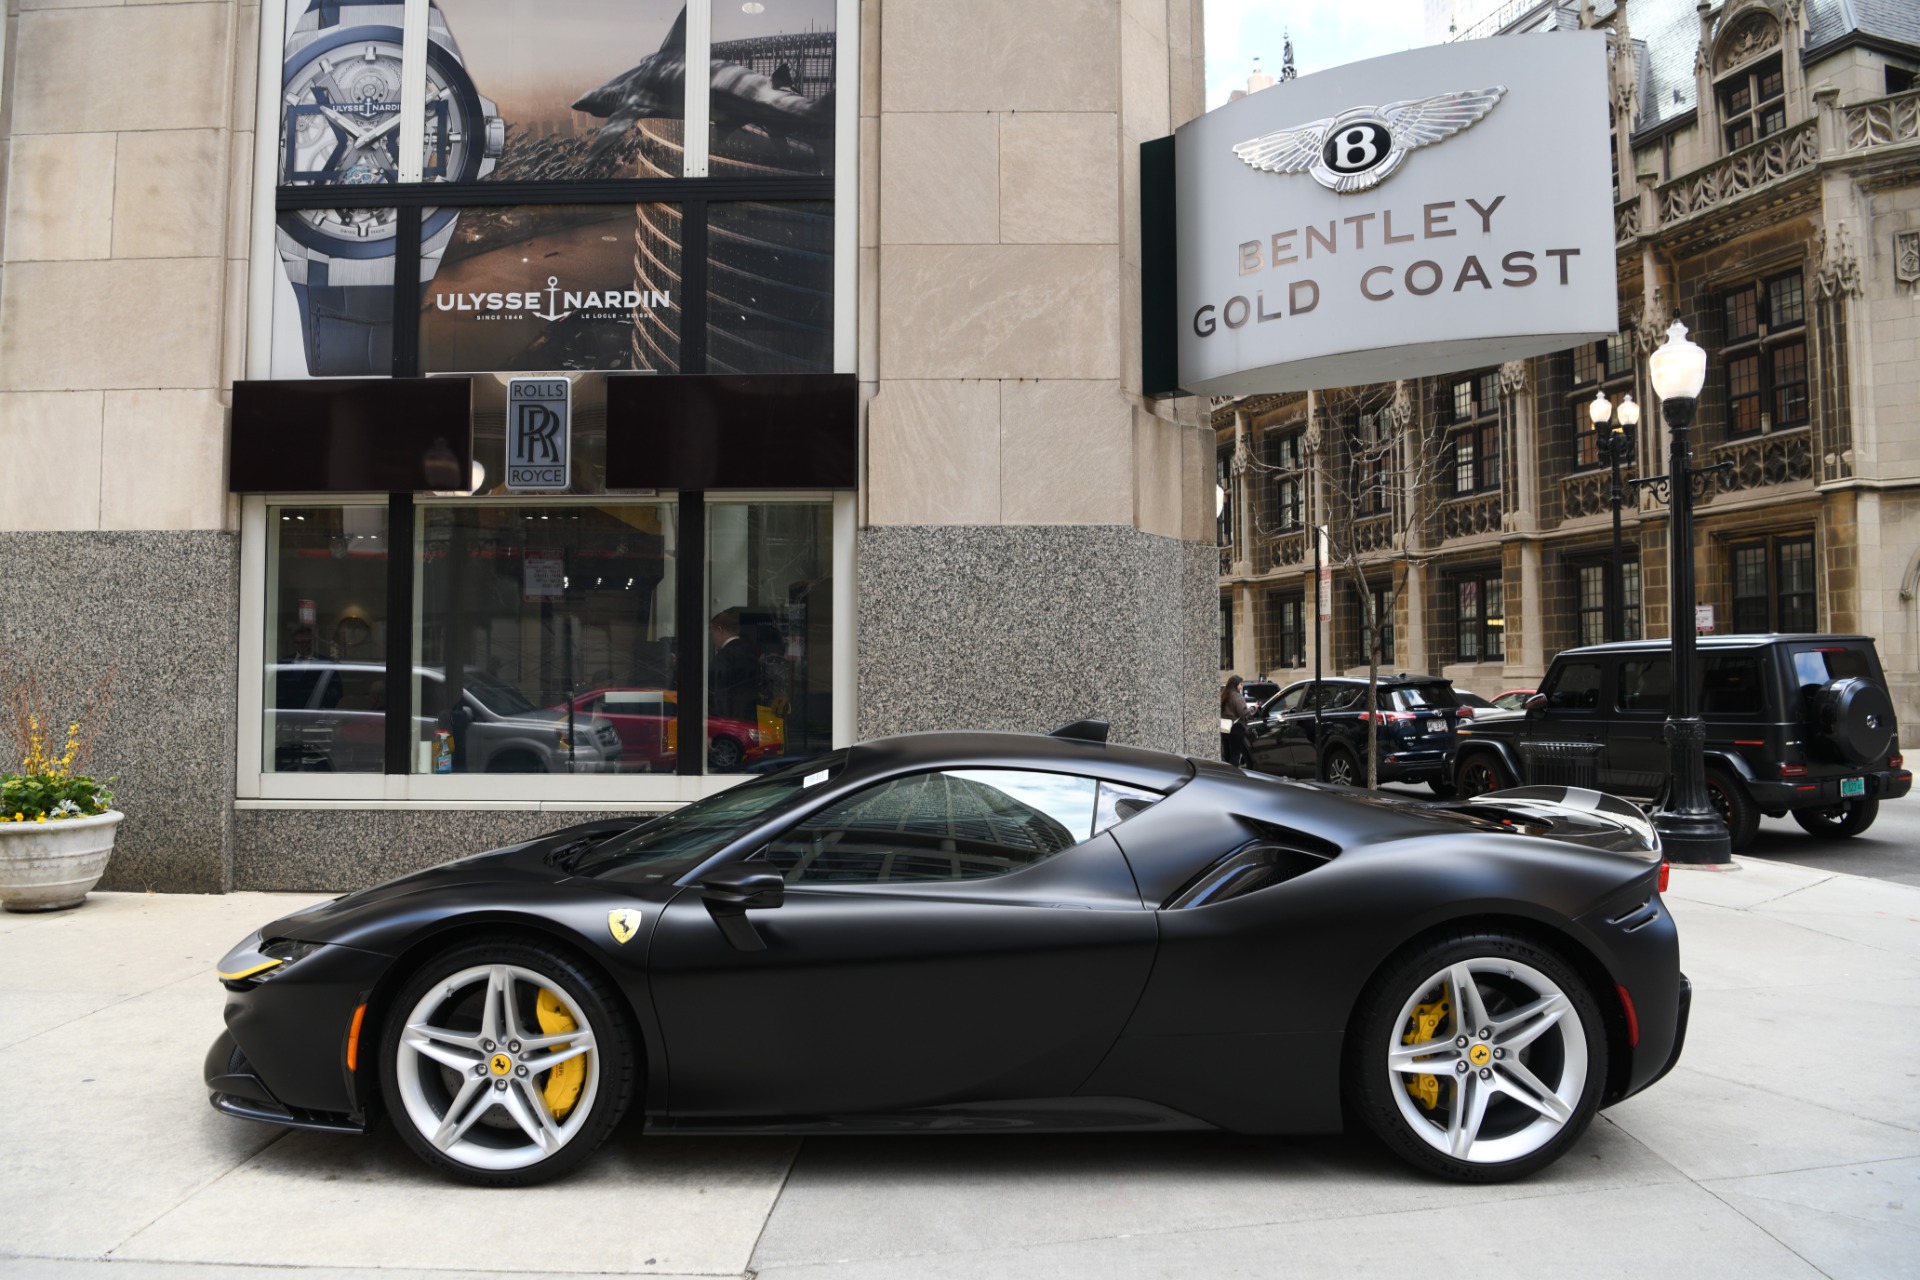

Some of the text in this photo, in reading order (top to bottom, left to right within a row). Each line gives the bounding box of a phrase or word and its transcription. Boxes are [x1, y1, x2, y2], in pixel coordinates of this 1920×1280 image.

[332, 103, 400, 112] ULYSSE NARDI
[1335, 125, 1377, 169] B
[1238, 195, 1506, 277] BENTLEY
[436, 290, 670, 311] ULYSSE NARDIN
[1193, 248, 1581, 338] GOLD COAST
[514, 384, 564, 397] ROLLS
[512, 469, 562, 482] ROYCE
